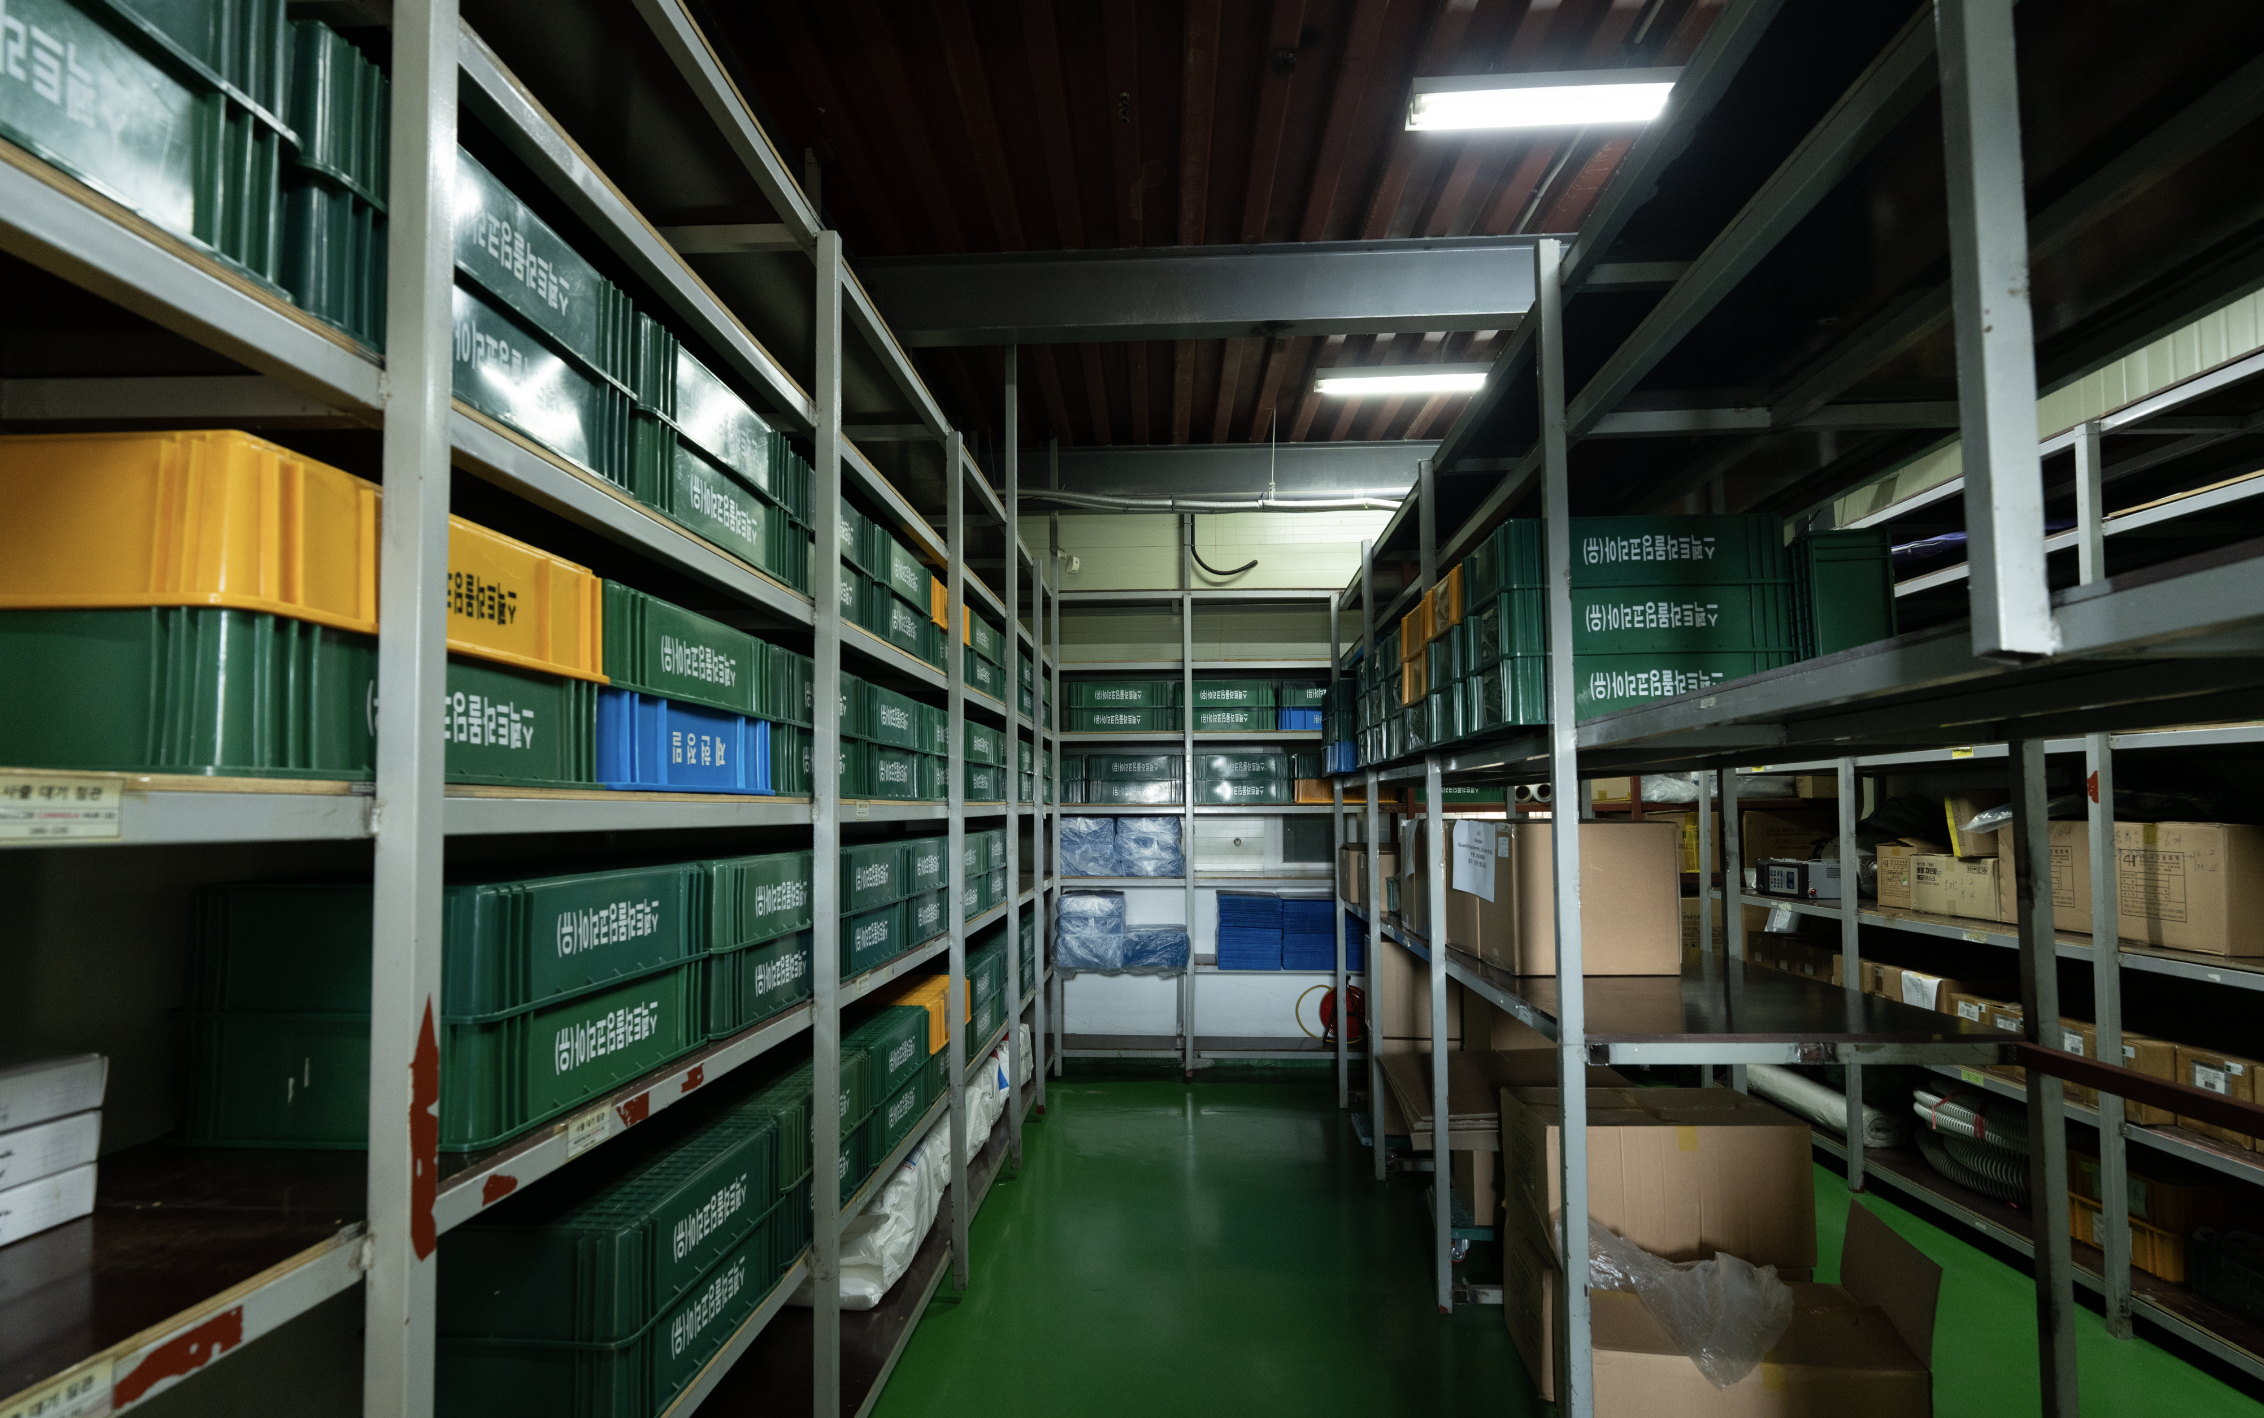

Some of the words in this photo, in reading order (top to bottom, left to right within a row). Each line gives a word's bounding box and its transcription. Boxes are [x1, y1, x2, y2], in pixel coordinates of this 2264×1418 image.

[1583, 535, 1716, 564] 스펙트라몰딩코리아(유)
[1585, 601, 1719, 632] 스펙트라몰딩코리아(유)
[661, 635, 736, 687] 스펙트라몰딩코리아(유)
[672, 731, 726, 767] 제현정밀
[755, 879, 808, 918] 스펙트라몰딩코리아(유)
[556, 898, 659, 958] 스펙트라몰딩코리아(유)
[755, 949, 807, 998] 스펙트라몰딩코리아(유)
[555, 1001, 659, 1076] 스펙트라몰딩코리아(유)
[673, 1172, 747, 1264] 스펙트라몰딩코리아(유)
[671, 1255, 746, 1361] 스펙트라몰딩코리아(유)
